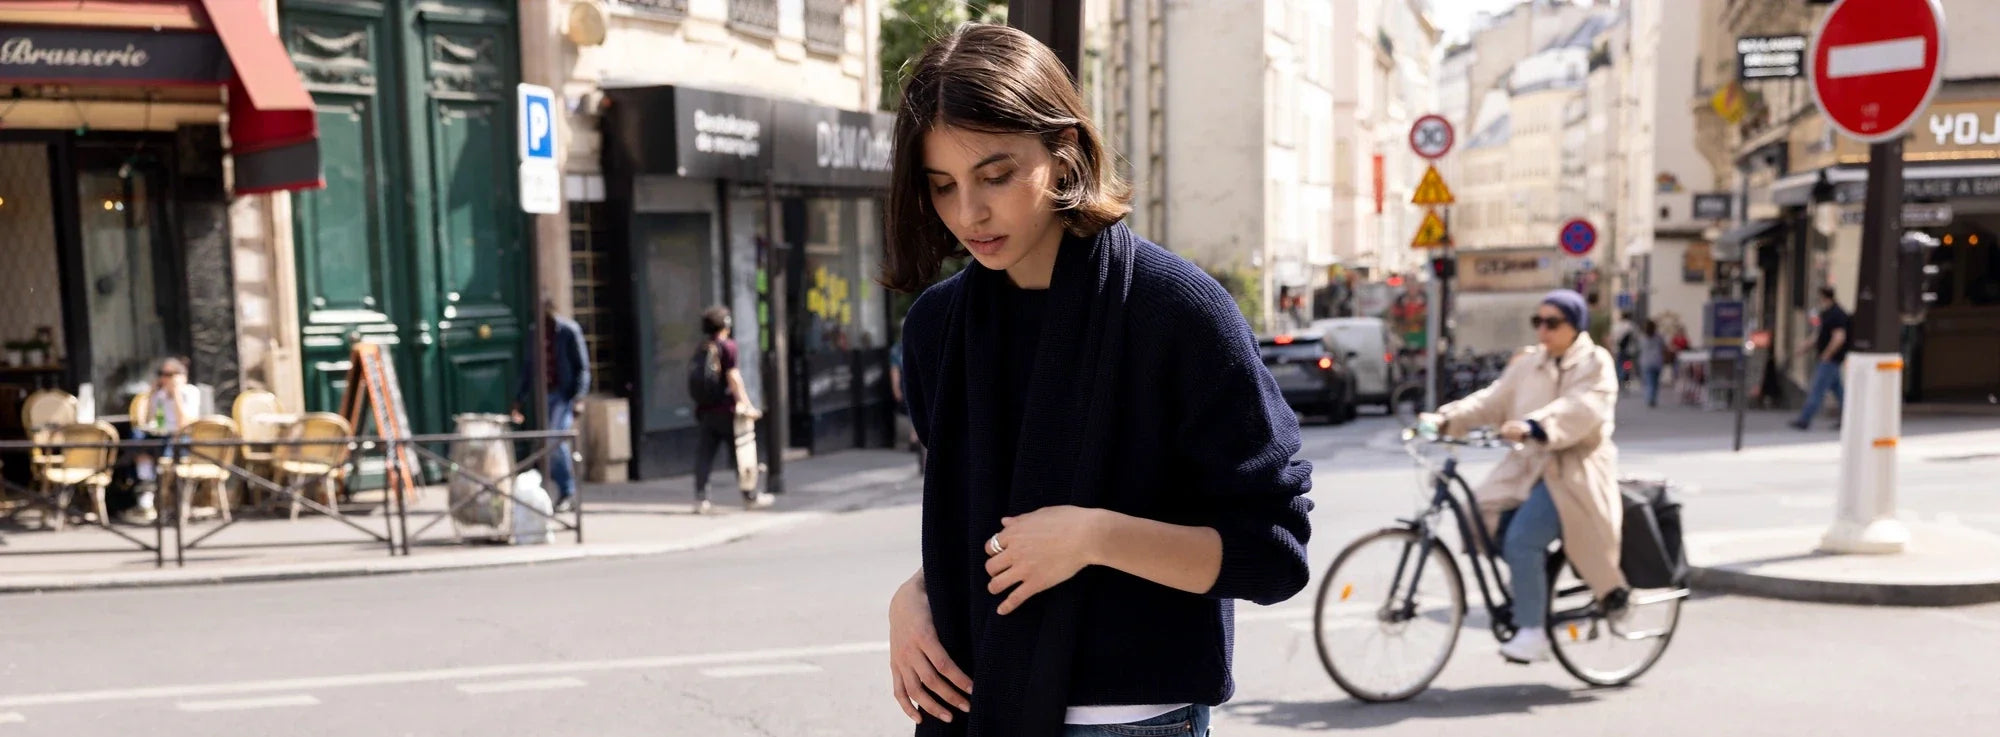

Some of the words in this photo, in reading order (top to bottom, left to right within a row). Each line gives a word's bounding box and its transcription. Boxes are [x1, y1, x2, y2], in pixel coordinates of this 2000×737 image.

[0, 37, 149, 67] Brasserie
[529, 101, 549, 152] P
[1418, 125, 1446, 149] 30
[1929, 112, 2000, 145] YOJ
